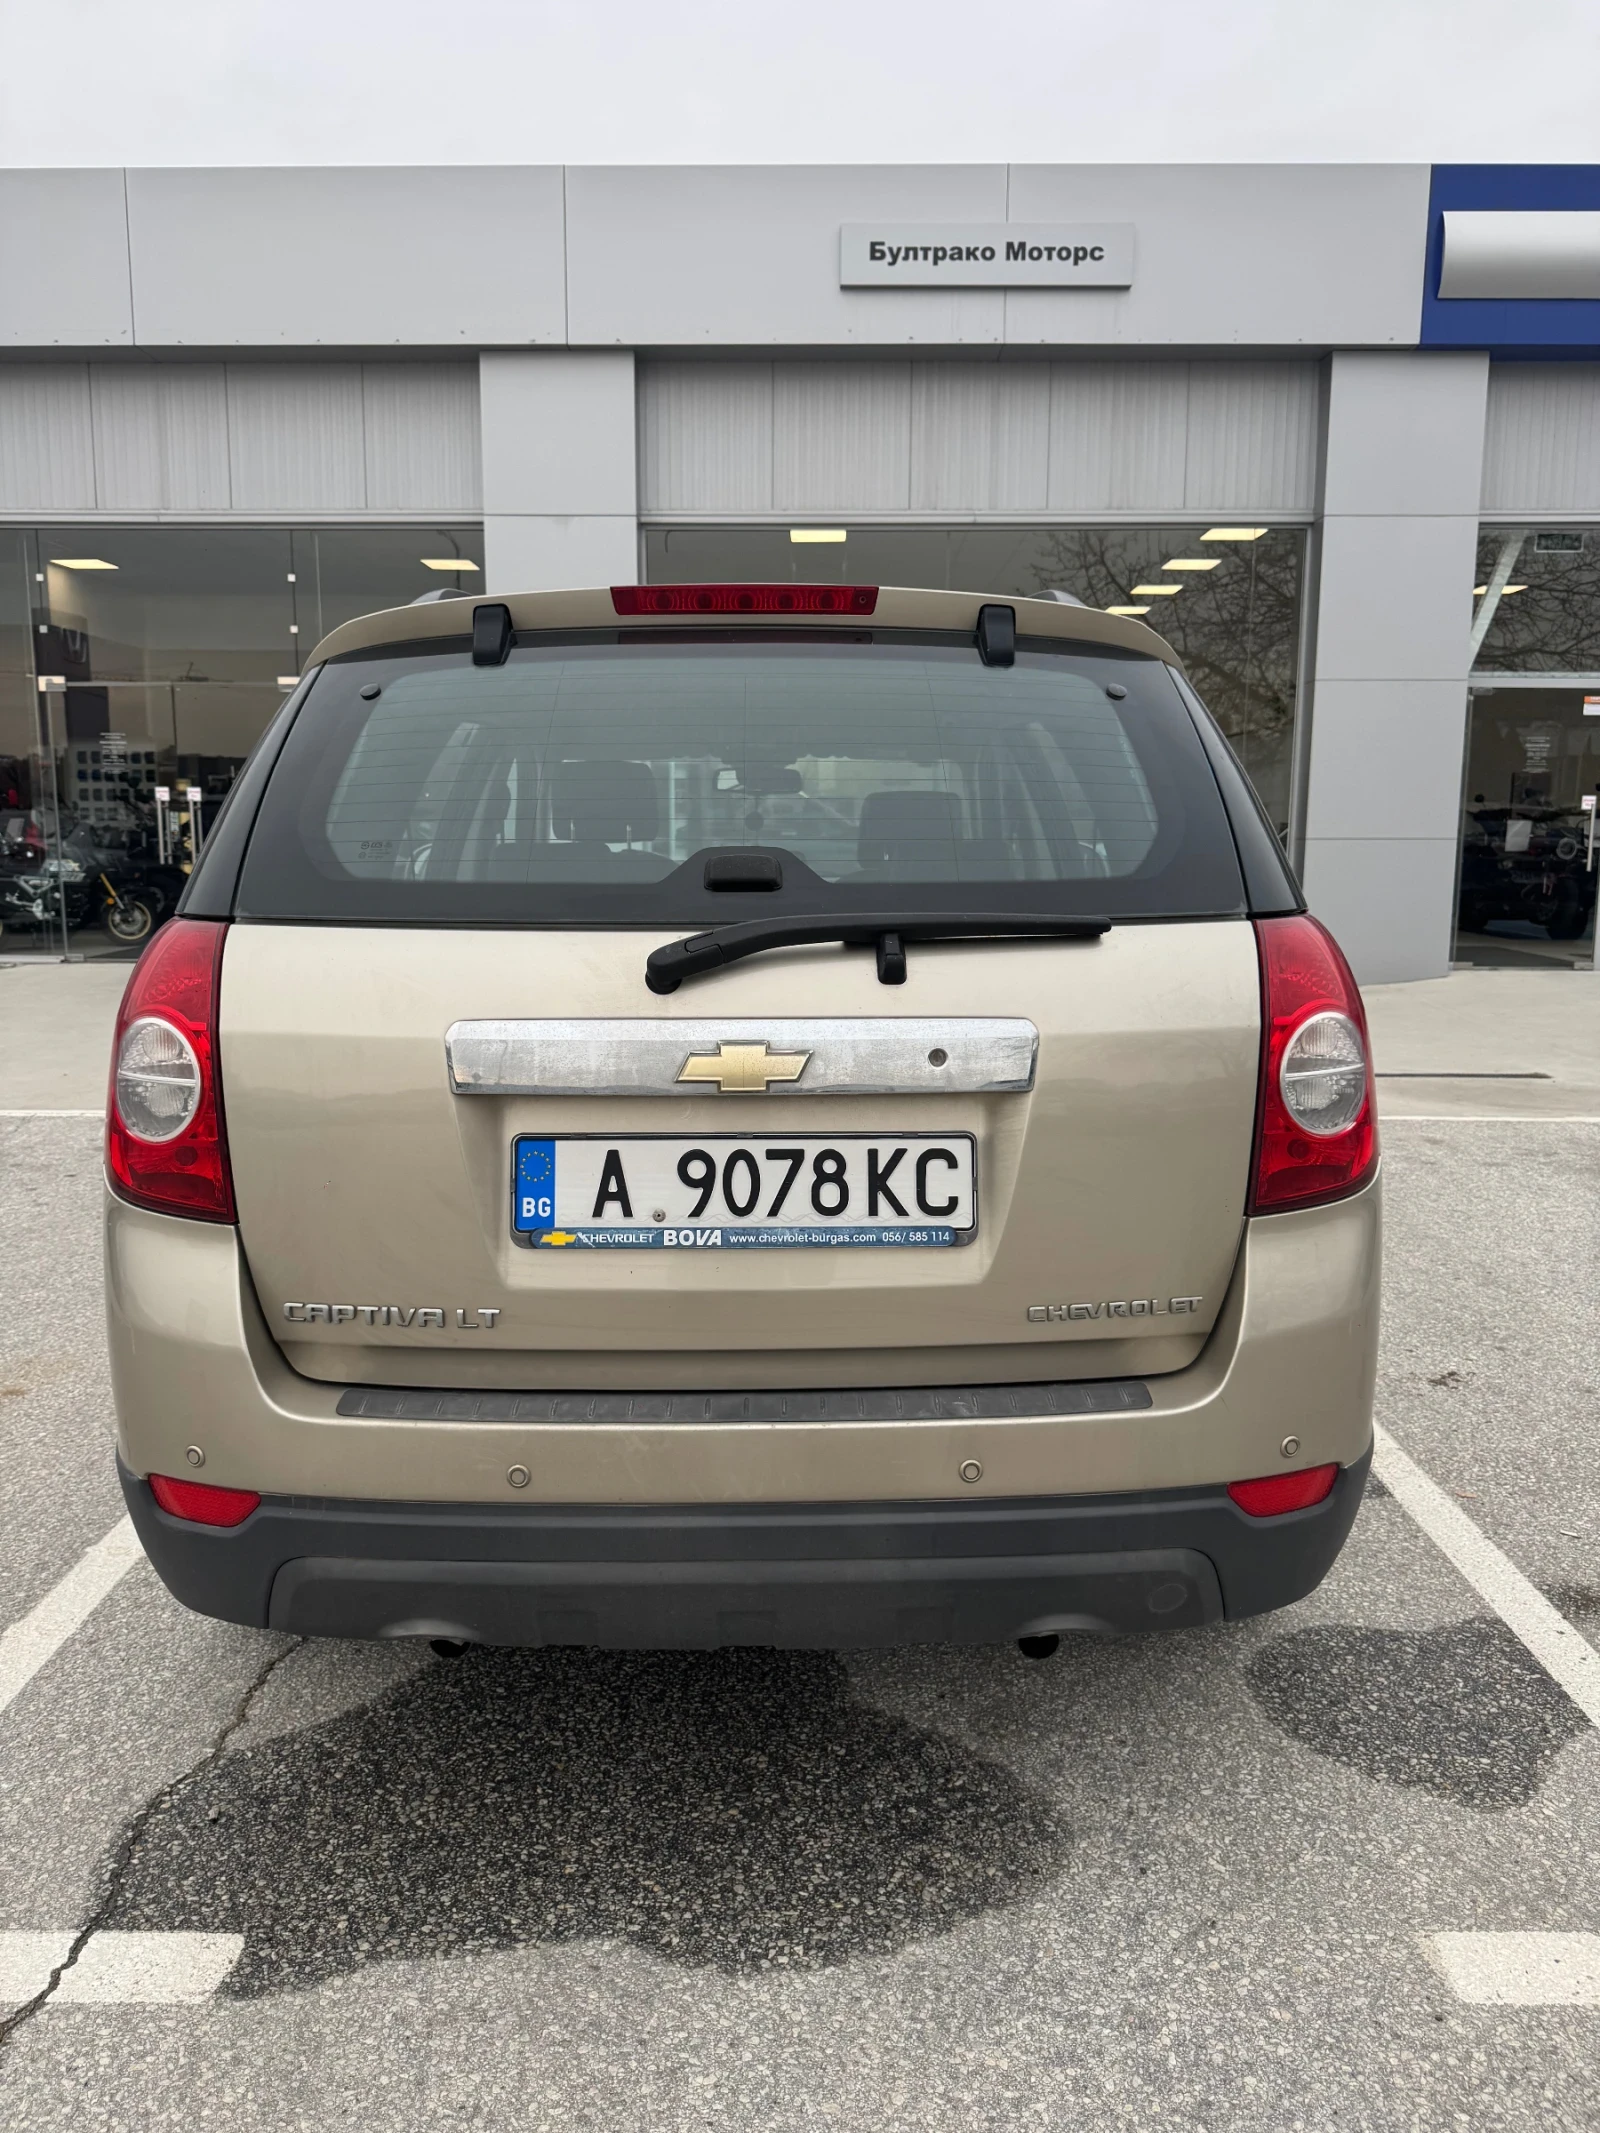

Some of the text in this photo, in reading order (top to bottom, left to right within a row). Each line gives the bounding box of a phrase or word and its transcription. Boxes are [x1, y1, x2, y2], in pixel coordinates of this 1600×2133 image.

[869, 241, 1105, 266] Бултрако Моторс
[592, 1149, 634, 1218] A
[522, 1197, 551, 1217] BG
[663, 1230, 722, 1246] BOVA
[729, 1232, 876, 1244] www.chevrolet-burgas.com
[882, 1232, 906, 1242] 056/
[909, 1232, 928, 1241] 585
[931, 1231, 950, 1241] 114
[284, 1302, 501, 1328] CAPTIVA LT
[1028, 1296, 1203, 1322] CHEVROLET
